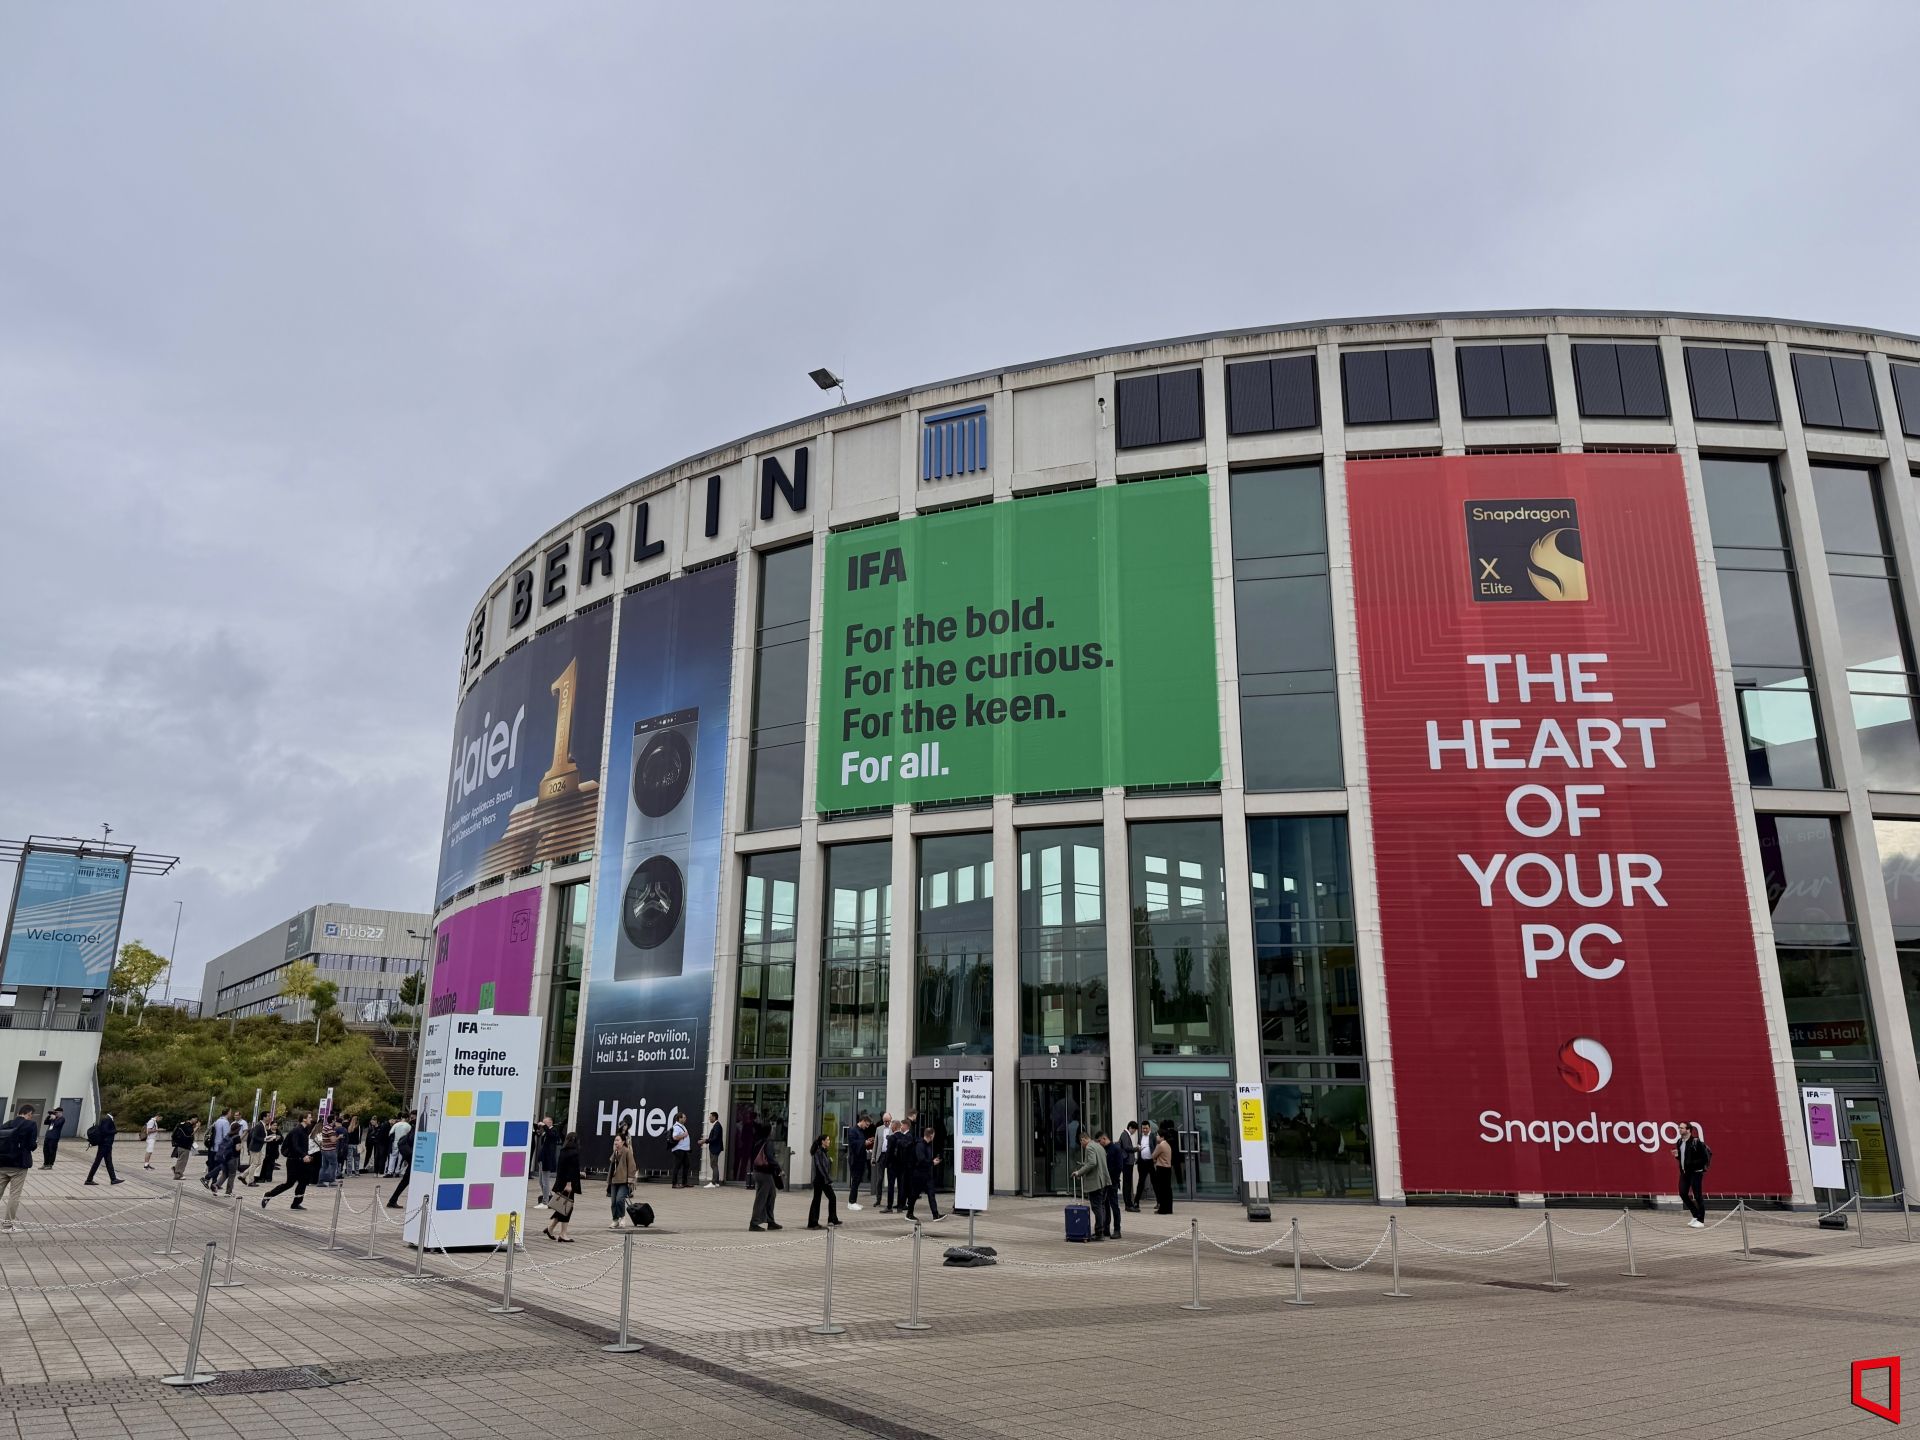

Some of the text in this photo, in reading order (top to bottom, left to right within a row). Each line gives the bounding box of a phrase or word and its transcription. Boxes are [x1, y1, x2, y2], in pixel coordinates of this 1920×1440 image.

[1472, 507, 1571, 523] Snapdragon
[510, 447, 808, 629] BERLIN
[848, 546, 907, 592] IFA
[1479, 558, 1501, 580] X
[1480, 582, 1513, 595] Elite
[846, 596, 1055, 657] For the bold.
[844, 642, 1114, 699] For the curious.
[1466, 653, 1614, 703] THE
[843, 693, 1066, 742] For the keen.
[1426, 718, 1667, 770] HEART
[449, 704, 525, 813] Haier
[841, 742, 949, 786] For all.
[495, 786, 513, 804] Brand
[549, 780, 567, 794] 2024
[1505, 784, 1605, 838] OF
[480, 813, 495, 827] Years
[1457, 852, 1669, 908] YOUR
[27, 928, 101, 944] Welcome!
[340, 925, 385, 939] hub27
[1521, 923, 1626, 980] PC
[457, 1021, 478, 1034] IFA
[1807, 1028, 1828, 1040] us!
[1831, 1027, 1860, 1039] Hall
[598, 1028, 691, 1045] Visit Haier Pavilion,
[455, 1047, 506, 1063] Imagine
[596, 1050, 614, 1063] Hall
[616, 1050, 628, 1062] 3.1
[637, 1048, 667, 1062] Booth
[669, 1047, 690, 1060] 101.
[933, 1058, 941, 1069] B
[1050, 1057, 1058, 1068] B
[454, 1063, 519, 1076] the future.
[962, 1075, 974, 1083] IFA
